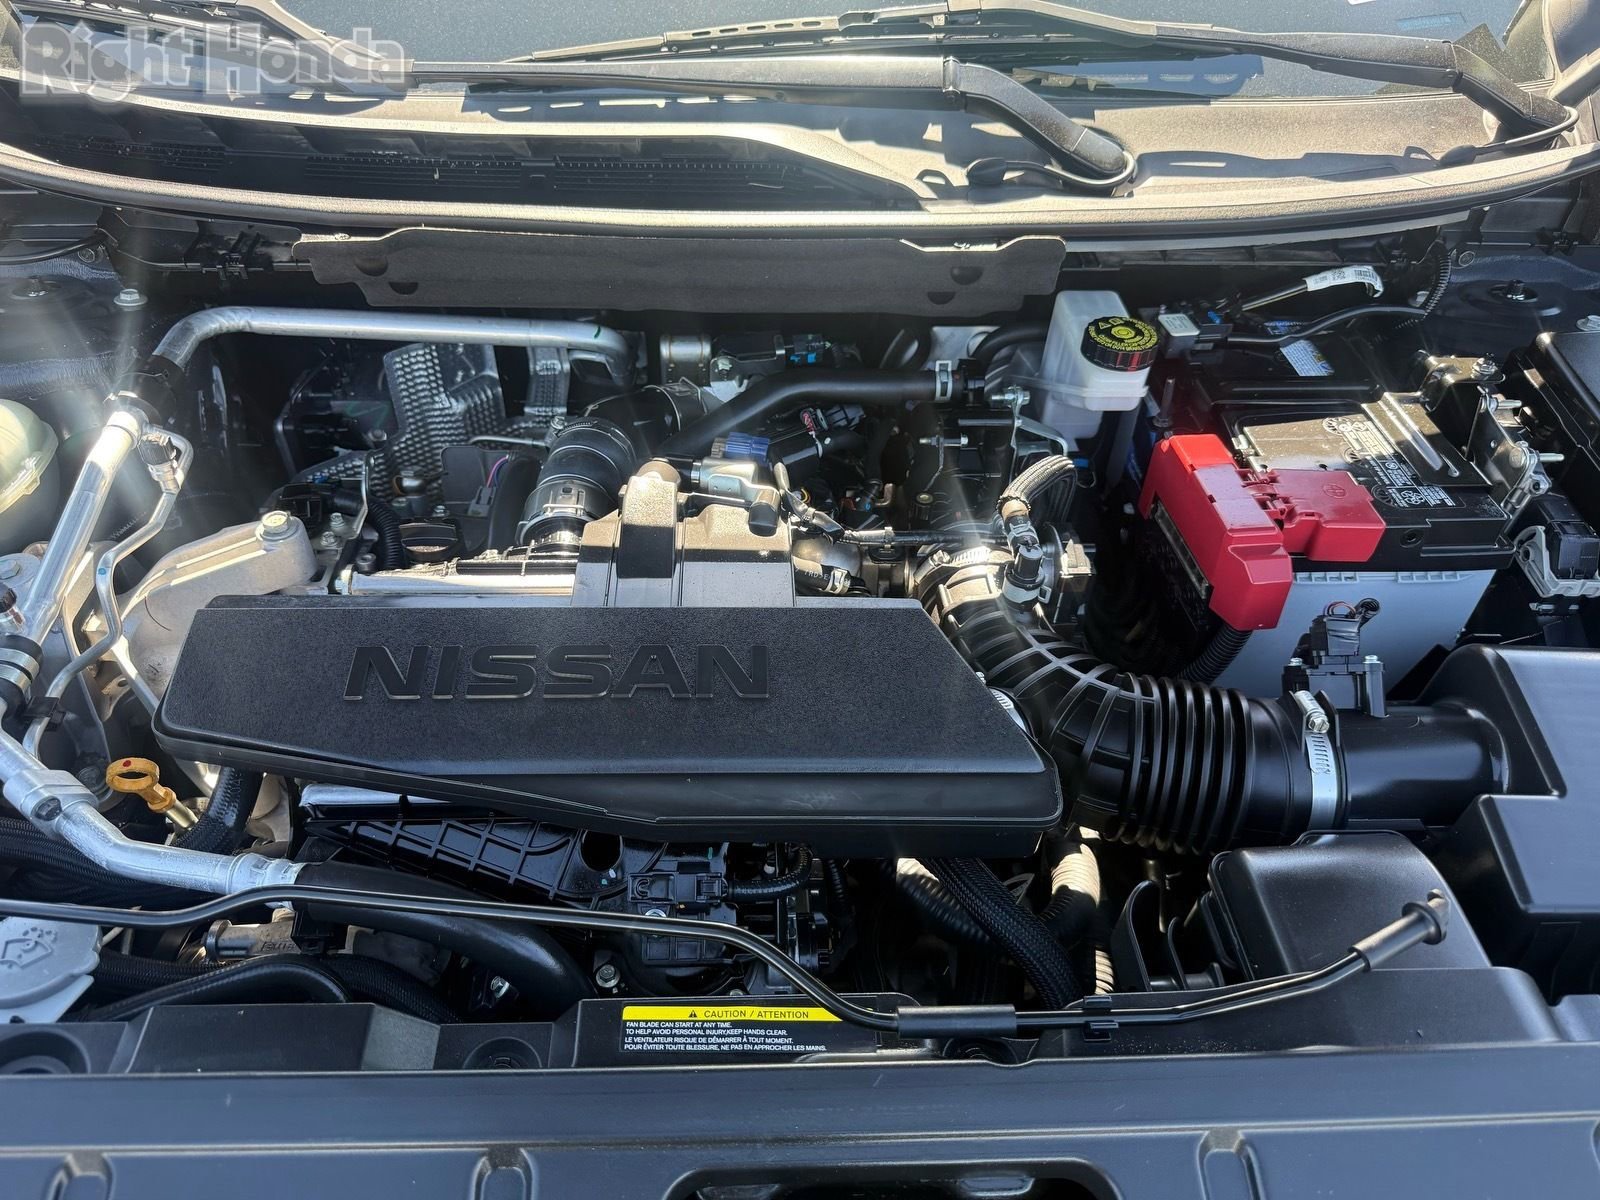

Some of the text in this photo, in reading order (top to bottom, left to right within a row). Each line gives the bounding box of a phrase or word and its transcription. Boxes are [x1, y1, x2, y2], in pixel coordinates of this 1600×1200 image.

[343, 645, 769, 699] NISSAN
[704, 1010, 809, 1019] CAUTION / ATTENTION
[742, 1035, 748, 1043] À
